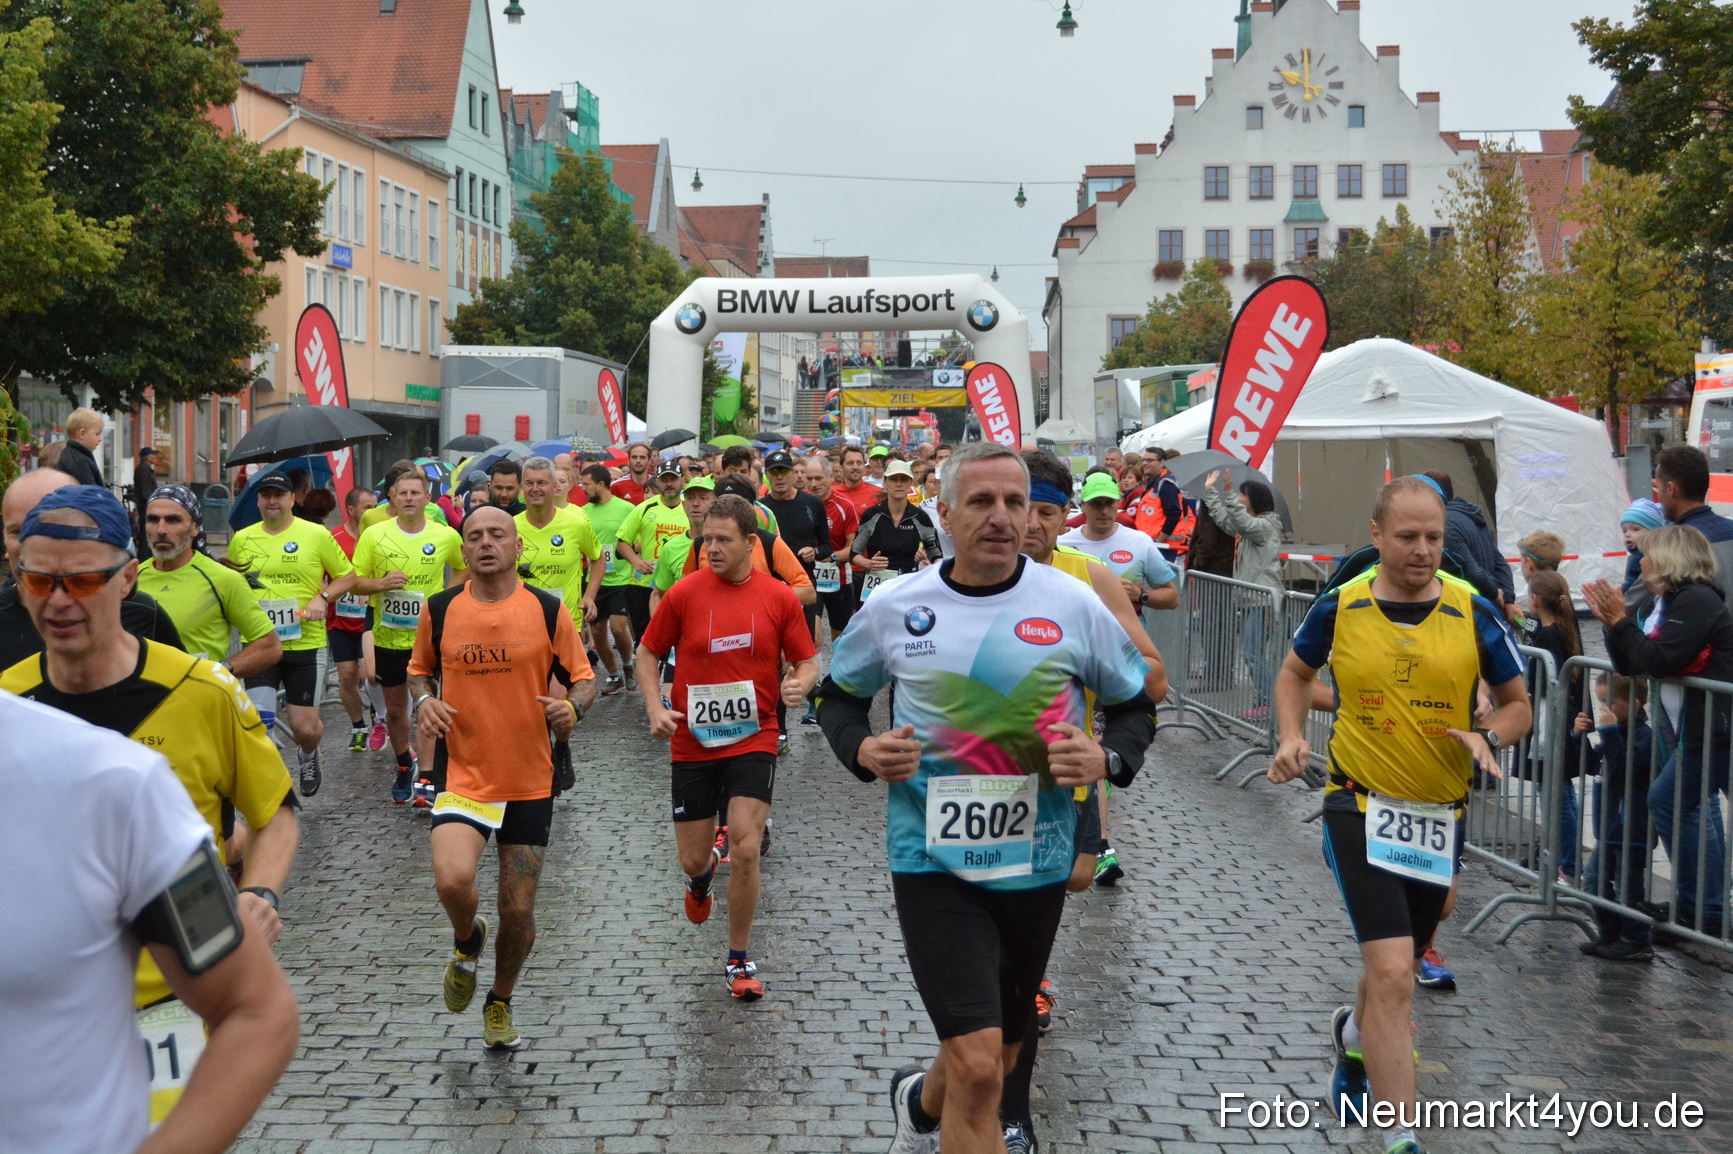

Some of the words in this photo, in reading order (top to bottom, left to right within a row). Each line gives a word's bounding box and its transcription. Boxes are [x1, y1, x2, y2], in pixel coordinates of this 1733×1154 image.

[717, 289, 800, 314] BMW
[808, 288, 955, 318] Laufsport
[1218, 302, 1312, 462] REWE
[890, 393, 919, 404] ZIEL
[656, 523, 687, 532] Müller
[383, 599, 420, 616] 2890
[1021, 624, 1058, 639] Hervis
[722, 639, 740, 648] DEHN
[905, 640, 936, 651] PARTL
[463, 649, 512, 665] OEXL
[905, 649, 936, 658] Neumarkt
[1359, 694, 1385, 706] Seidl
[1409, 694, 1454, 710] RÖDL
[695, 697, 752, 724] 2649
[1416, 718, 1451, 729] PIZZERIA
[1421, 726, 1447, 735] ELIO
[706, 726, 743, 738] Thomas
[139, 736, 165, 746] TSV
[443, 795, 484, 814] Christian
[940, 801, 1029, 840] 2602
[1376, 808, 1447, 851] 2815
[964, 849, 1002, 867] Ralph
[1386, 848, 1433, 870] Joachim
